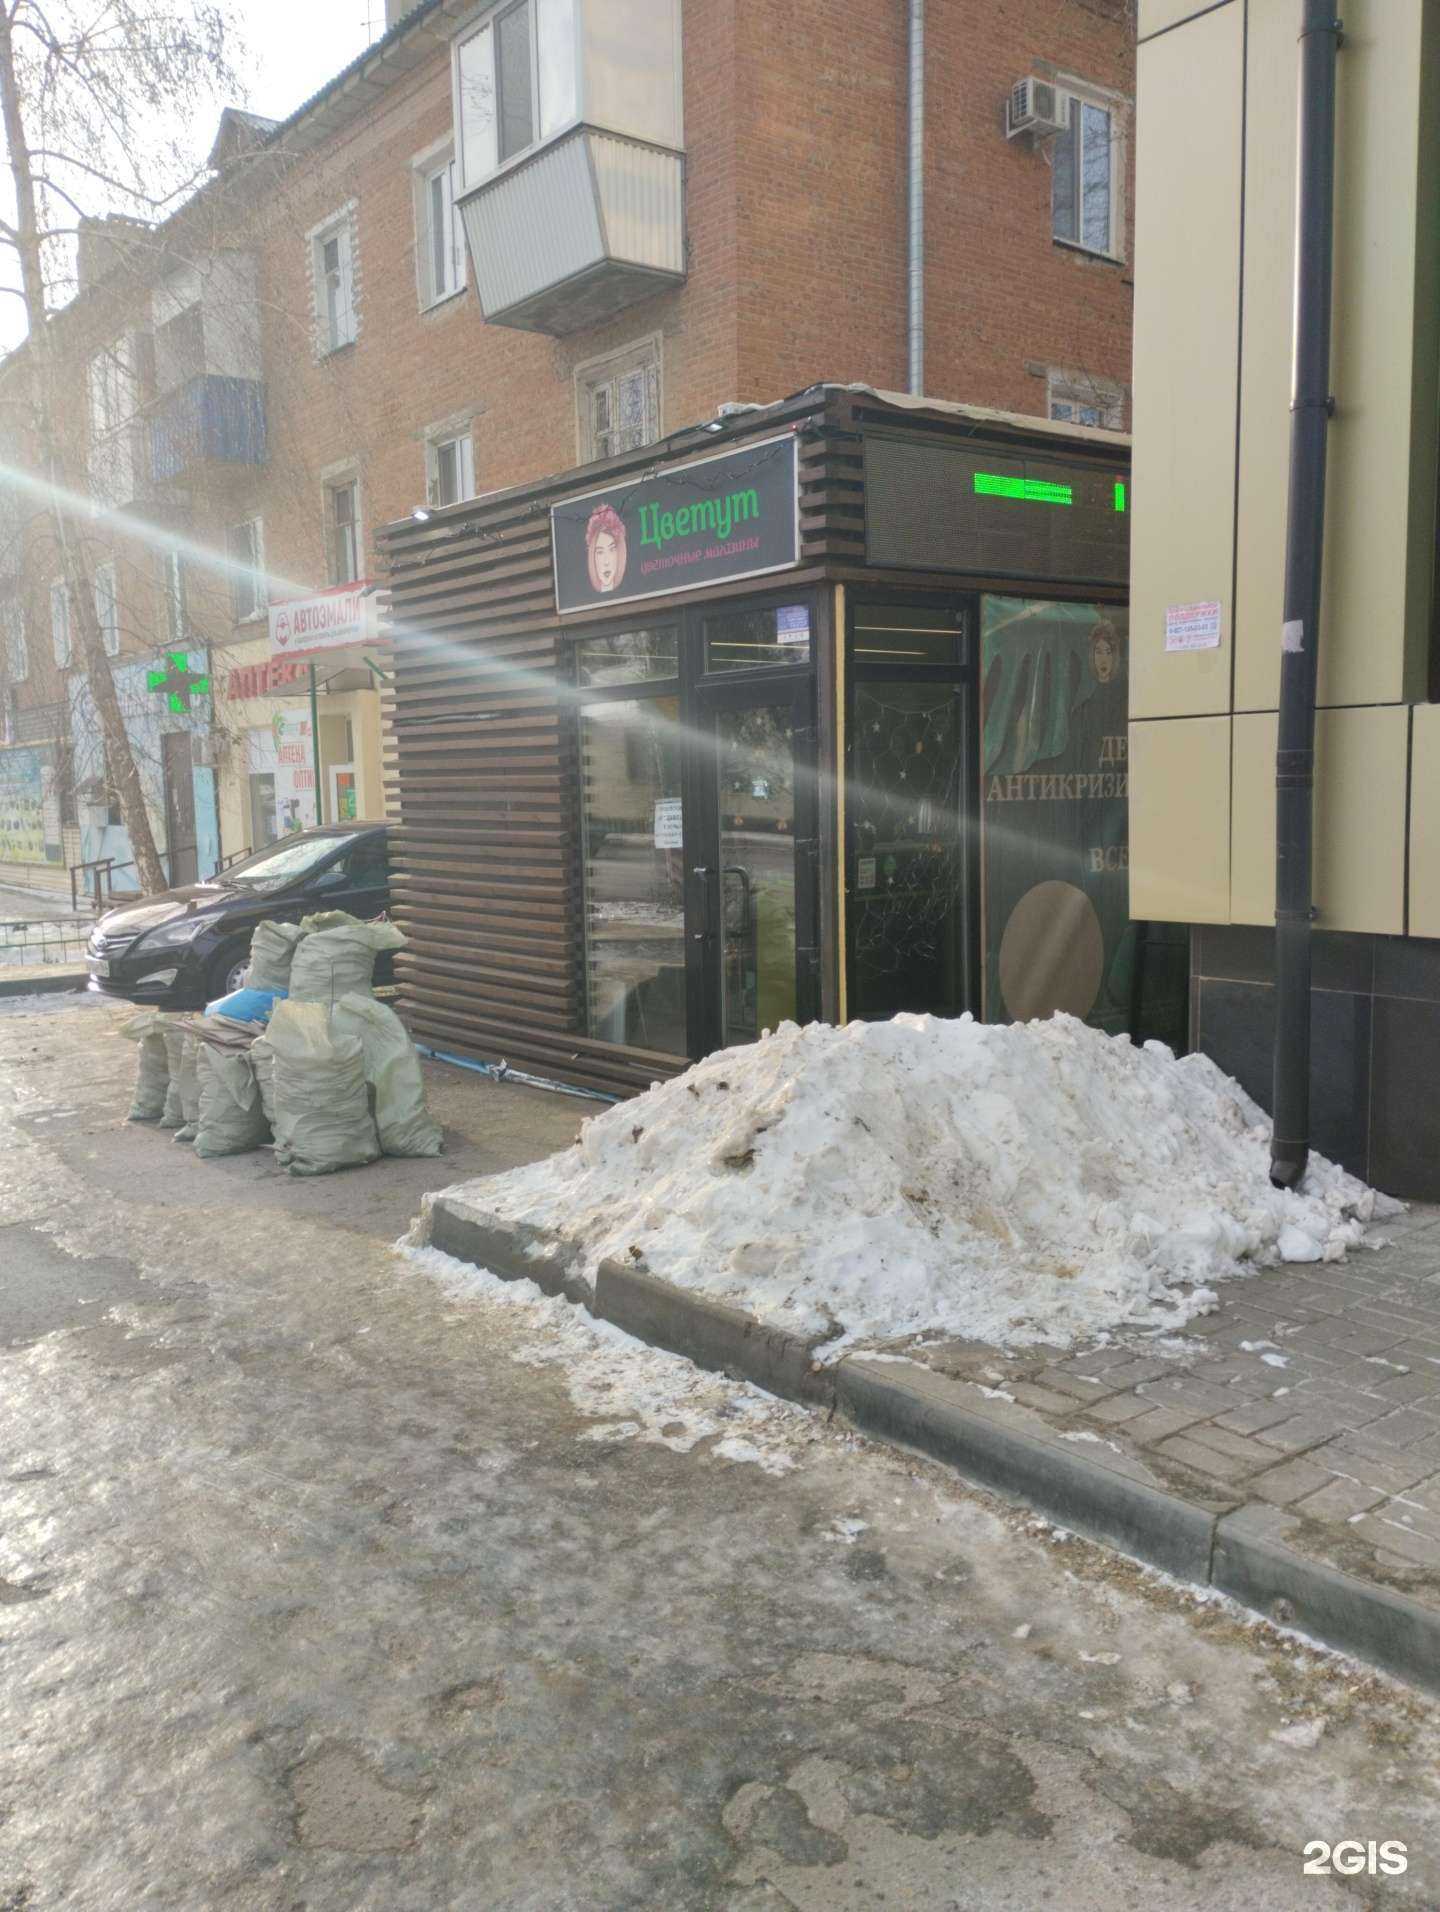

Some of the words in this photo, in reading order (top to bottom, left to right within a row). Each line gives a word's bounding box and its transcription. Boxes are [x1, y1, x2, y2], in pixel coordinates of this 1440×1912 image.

[639, 489, 759, 549] Цветут
[1098, 736, 1128, 768] ДЕ
[987, 773, 1128, 801] АНТИКРИЗИ
